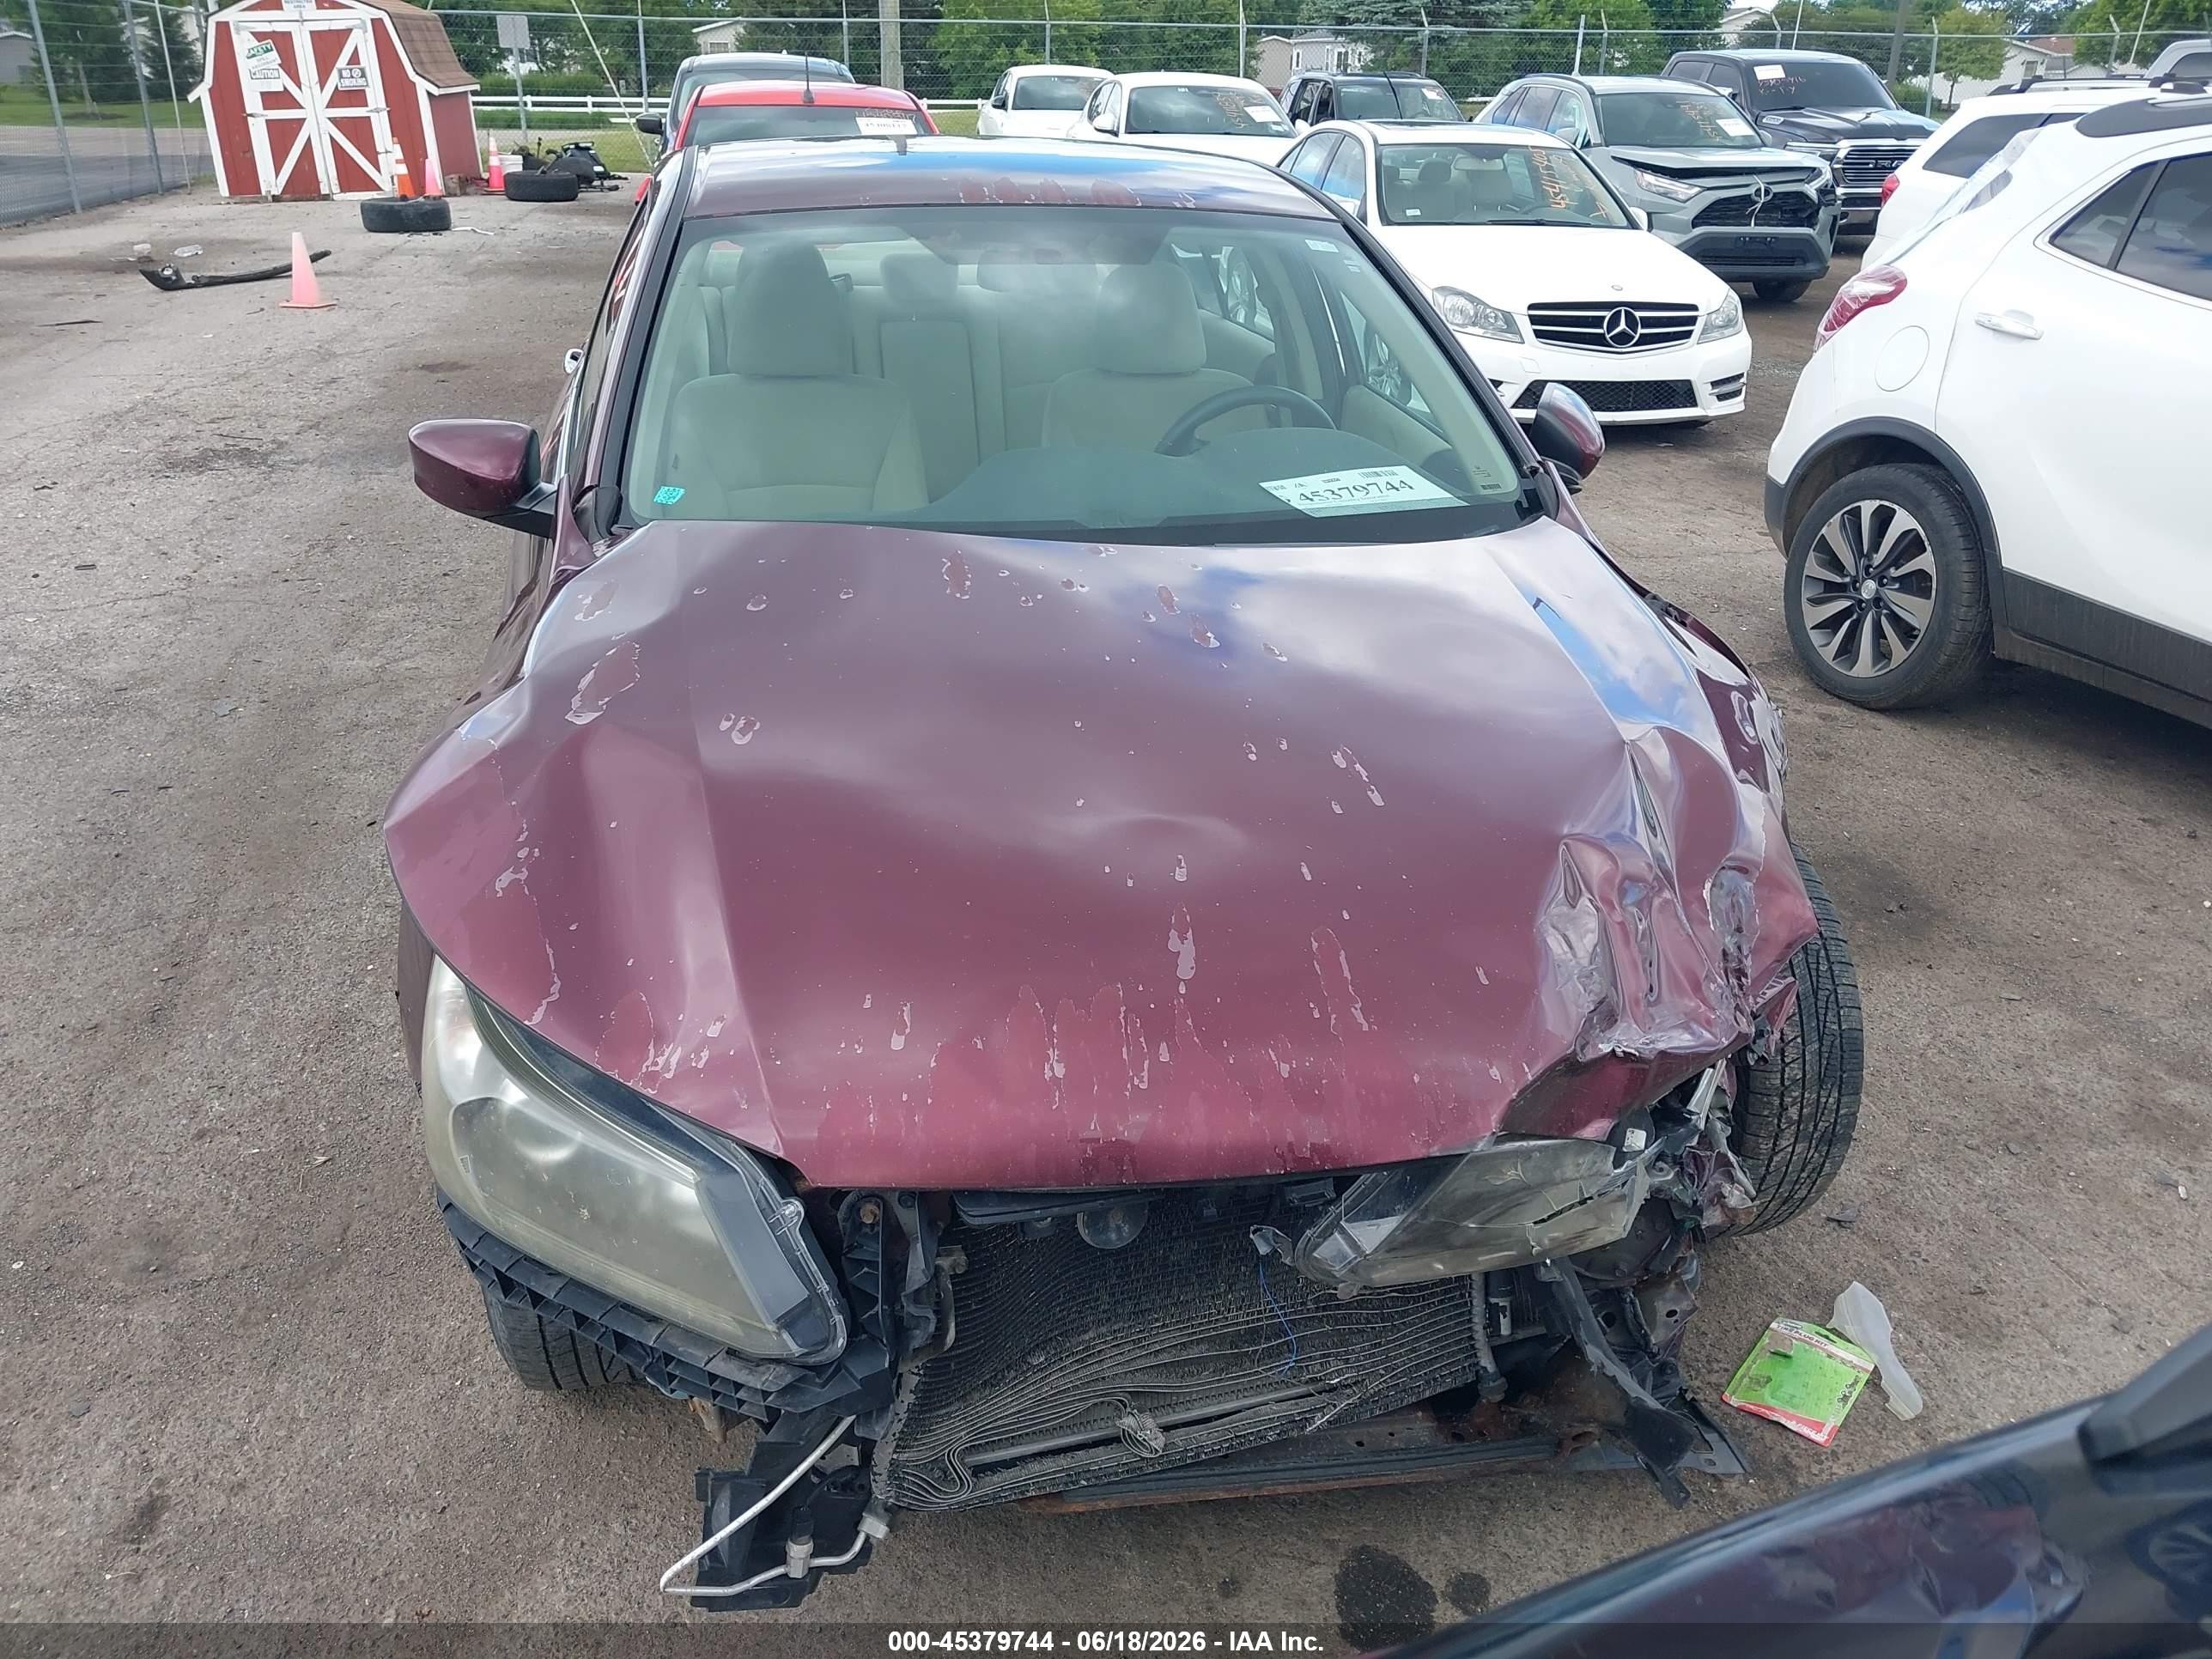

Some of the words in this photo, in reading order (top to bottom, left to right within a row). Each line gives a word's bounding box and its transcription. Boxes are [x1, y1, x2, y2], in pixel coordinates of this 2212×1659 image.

[246, 44, 272, 57] SAFETY
[251, 69, 280, 79] CAUTION
[342, 69, 351, 78] NO
[340, 77, 368, 87] SMOKING
[1298, 479, 1415, 502] 45379744
